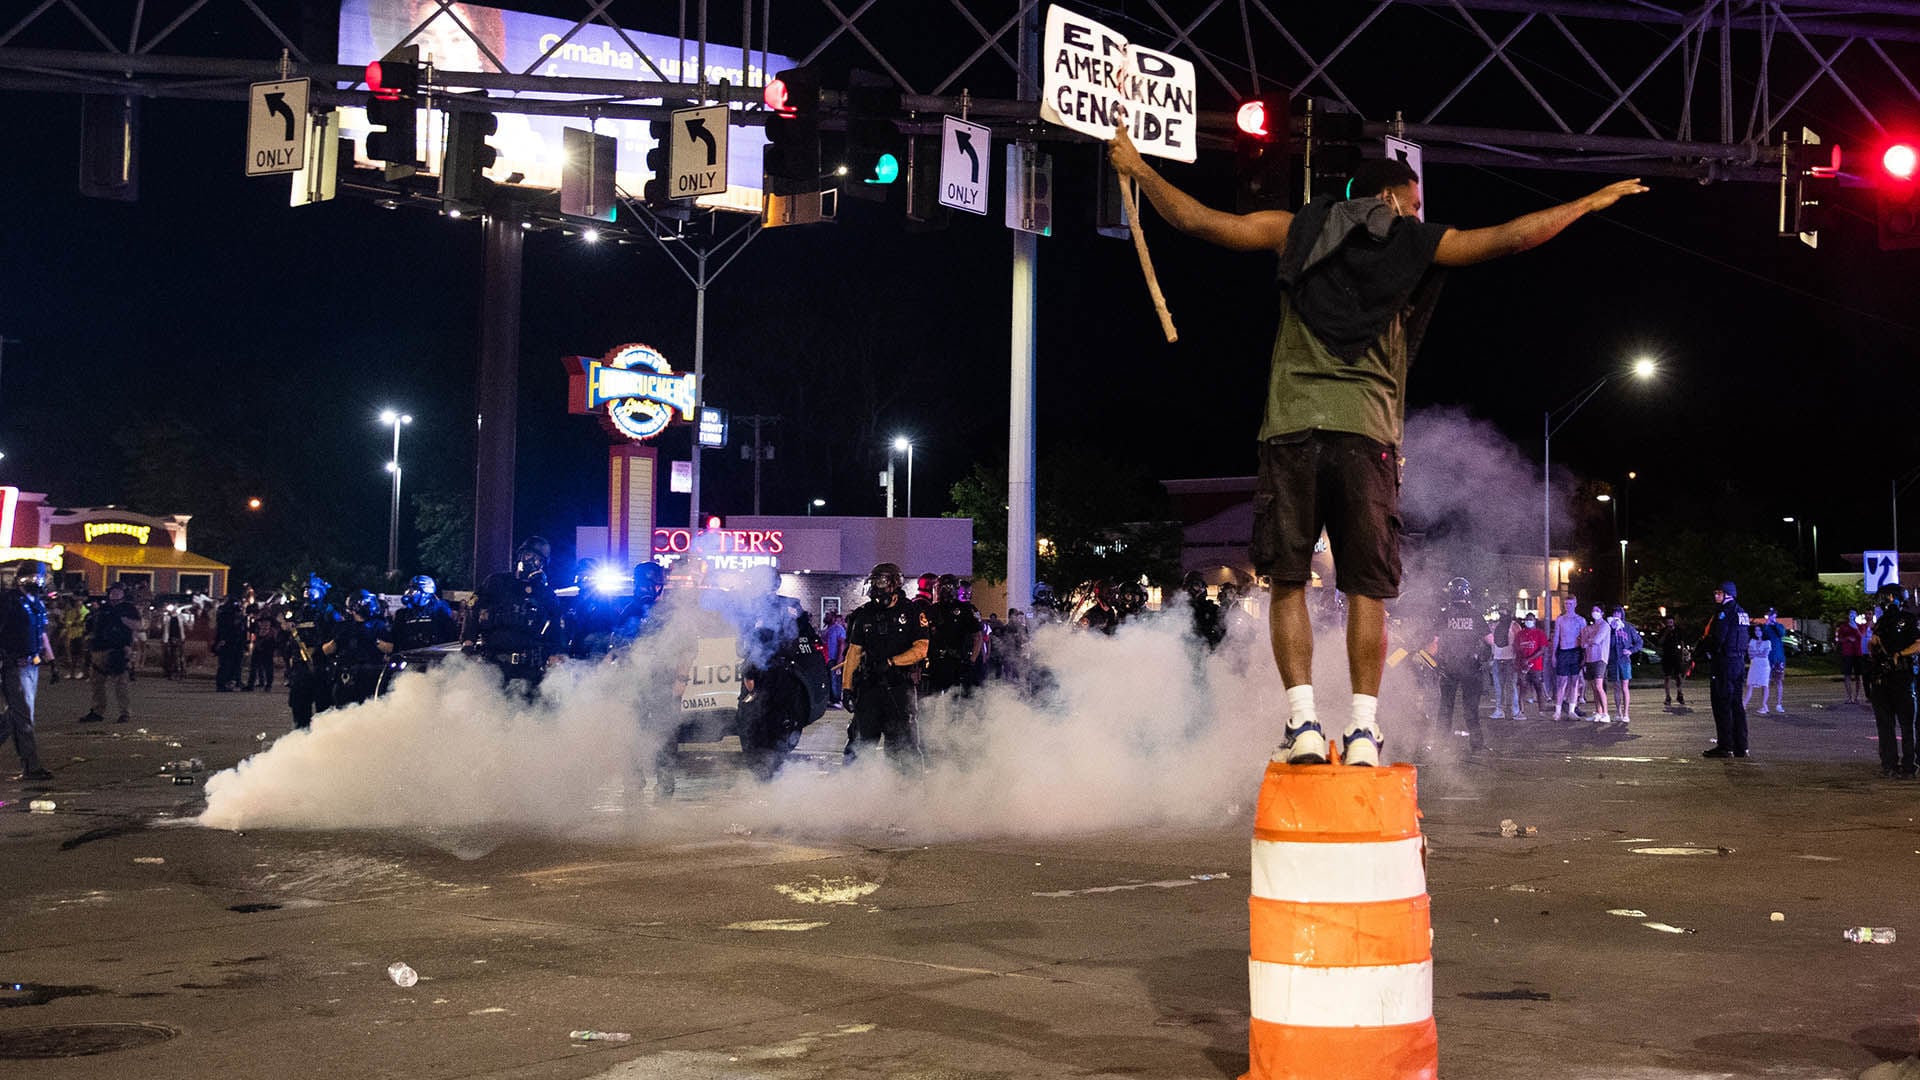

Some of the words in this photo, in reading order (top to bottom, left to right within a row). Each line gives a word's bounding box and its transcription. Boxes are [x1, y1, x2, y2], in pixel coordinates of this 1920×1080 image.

[539, 33, 653, 73] Omaha's
[1064, 23, 1176, 78] END
[256, 147, 295, 168] ONLY
[679, 172, 716, 191] ONLY
[948, 184, 978, 205] ONLY
[588, 361, 696, 421] FUCKERS
[654, 529, 784, 553] COTER'S
[1447, 618, 1473, 630] POLICE
[686, 664, 744, 685] LICE
[682, 697, 717, 709] OMAHA
